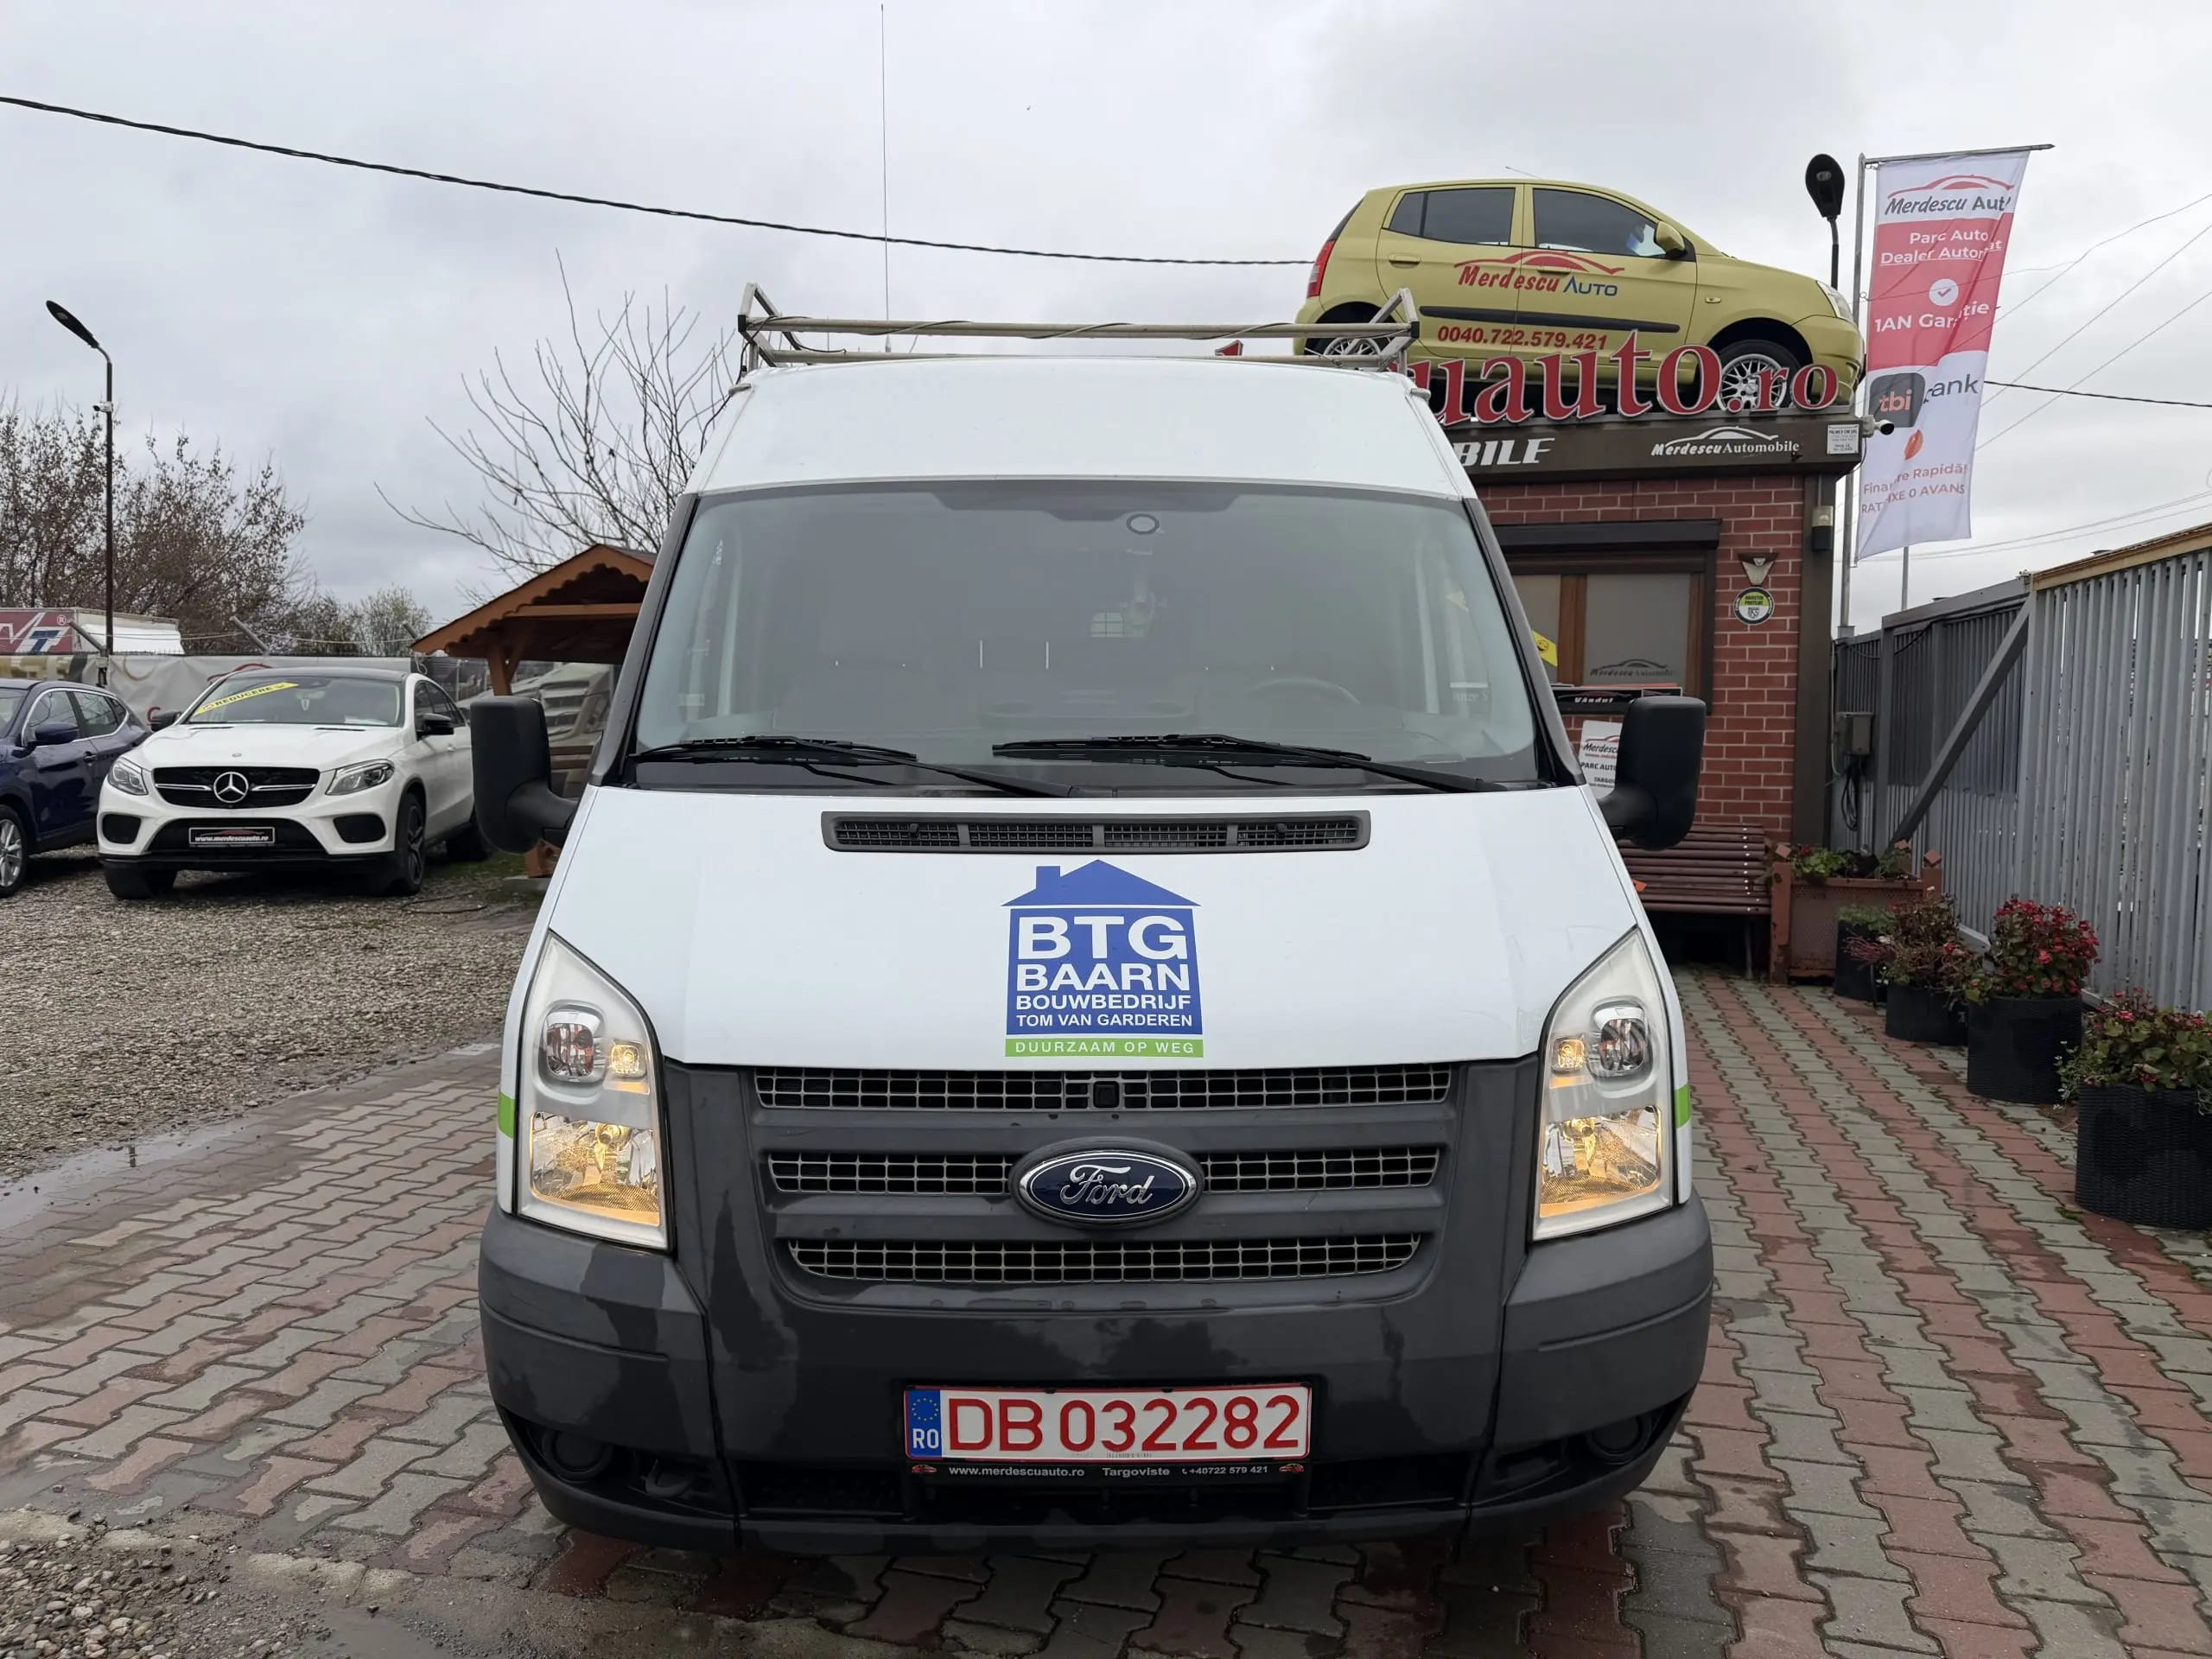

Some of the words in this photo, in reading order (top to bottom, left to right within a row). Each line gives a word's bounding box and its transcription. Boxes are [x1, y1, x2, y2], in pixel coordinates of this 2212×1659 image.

[1885, 196, 1967, 215] Merdescu
[1972, 197, 2011, 212] Aut
[1910, 232, 1946, 245] Parc
[1950, 229, 1988, 242] Auto
[1881, 251, 1934, 264] Dealer
[1458, 265, 1560, 292] Merdescu
[1437, 325, 1607, 350] 0040.722.579.421
[1878, 389, 1912, 412] tbi
[1650, 442, 1723, 456] Merdescu
[1723, 441, 1800, 454] Automobile
[1920, 483, 1965, 497] AVANS
[214, 686, 274, 706] REDUCERE
[1583, 743, 1618, 753] Merdesc
[1018, 915, 1188, 960] BTG
[1016, 963, 1190, 991] BAARN
[1016, 995, 1191, 1010] BOUWBEDRIJF
[1016, 1014, 1053, 1027] TOM
[1058, 1014, 1091, 1027] VAN
[1096, 1014, 1192, 1027] GARDEREN
[1015, 1042, 1116, 1053] DUURZAAM
[1124, 1042, 1147, 1053] OP
[1155, 1042, 1194, 1053] WEG
[1060, 1164, 1154, 1205] Ford
[949, 1397, 1043, 1452] DB
[1059, 1395, 1300, 1452] 032282
[912, 1428, 939, 1449] RO
[949, 1465, 1085, 1477] www.merdescuauto.ro
[1102, 1467, 1170, 1478] Targoviste
